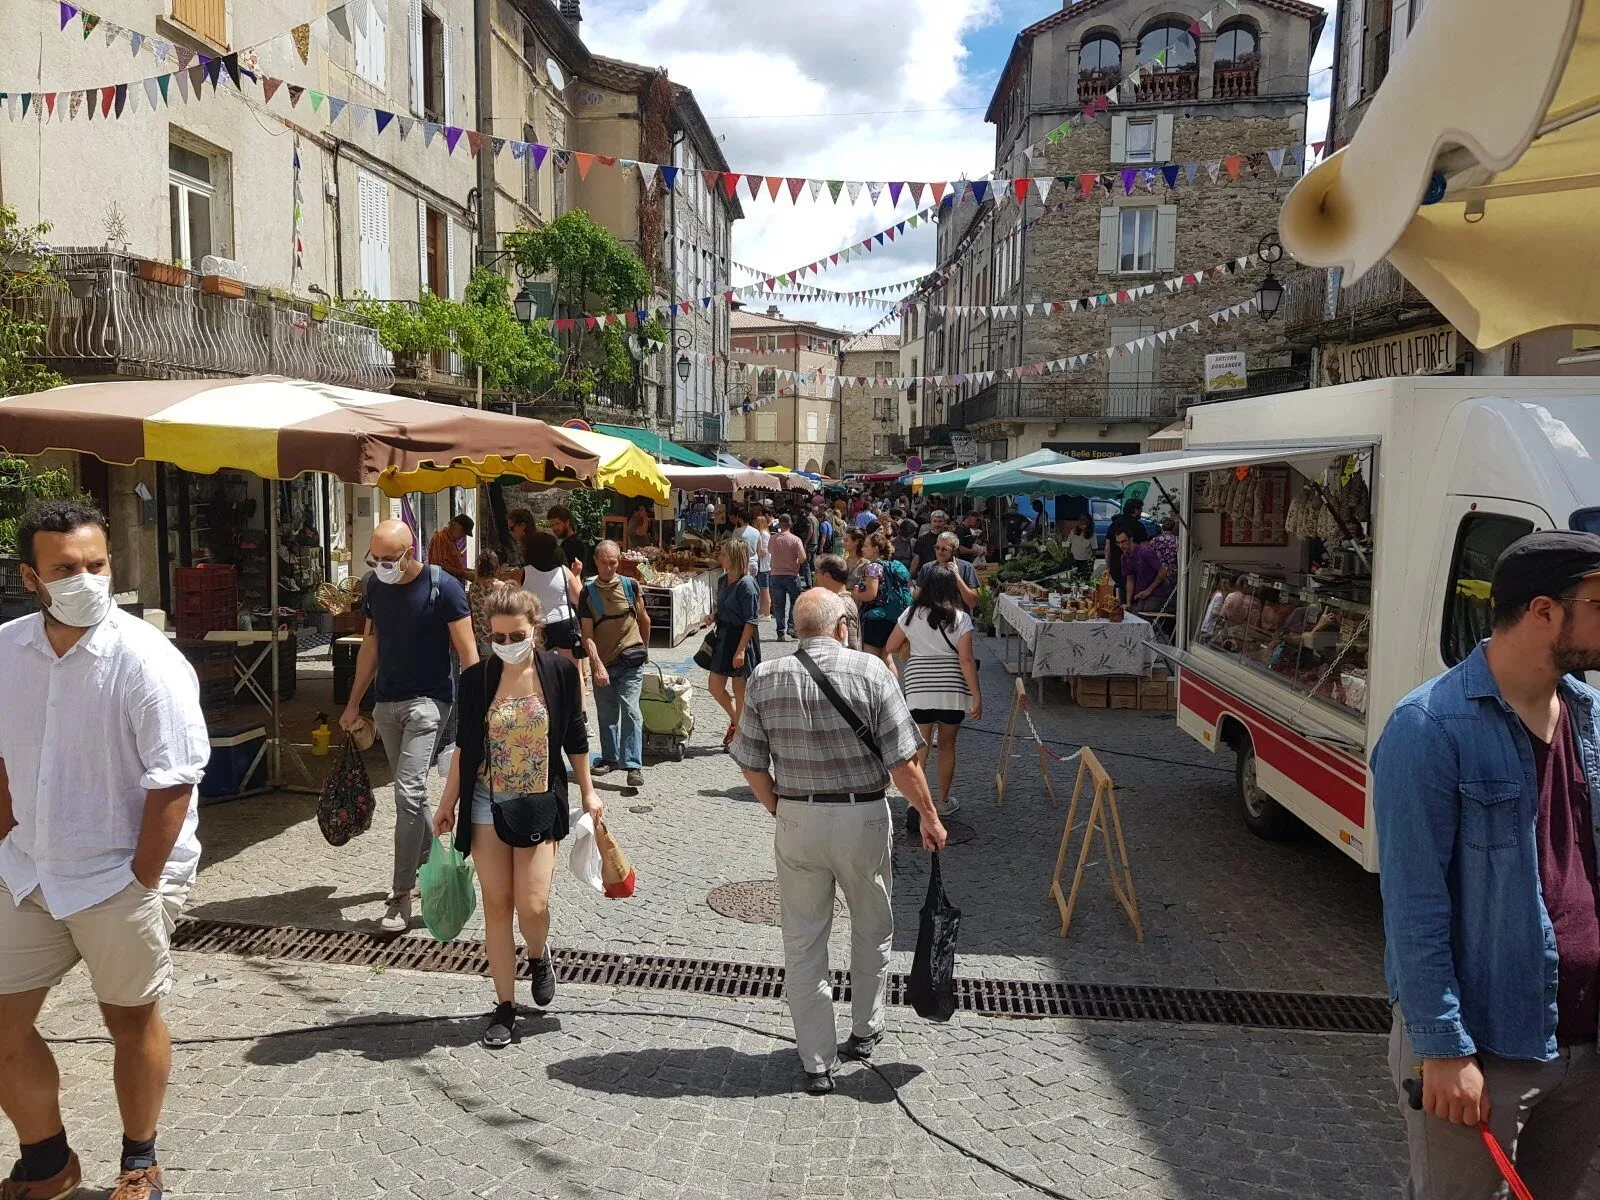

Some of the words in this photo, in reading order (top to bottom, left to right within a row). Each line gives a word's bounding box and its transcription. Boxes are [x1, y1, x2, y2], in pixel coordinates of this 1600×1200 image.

[1215, 354, 1237, 362] ARTISAN
[1384, 341, 1398, 378] DE
[1399, 338, 1415, 376] LA
[1211, 361, 1242, 369] BOULANGER
[1071, 449, 1091, 458] Belle
